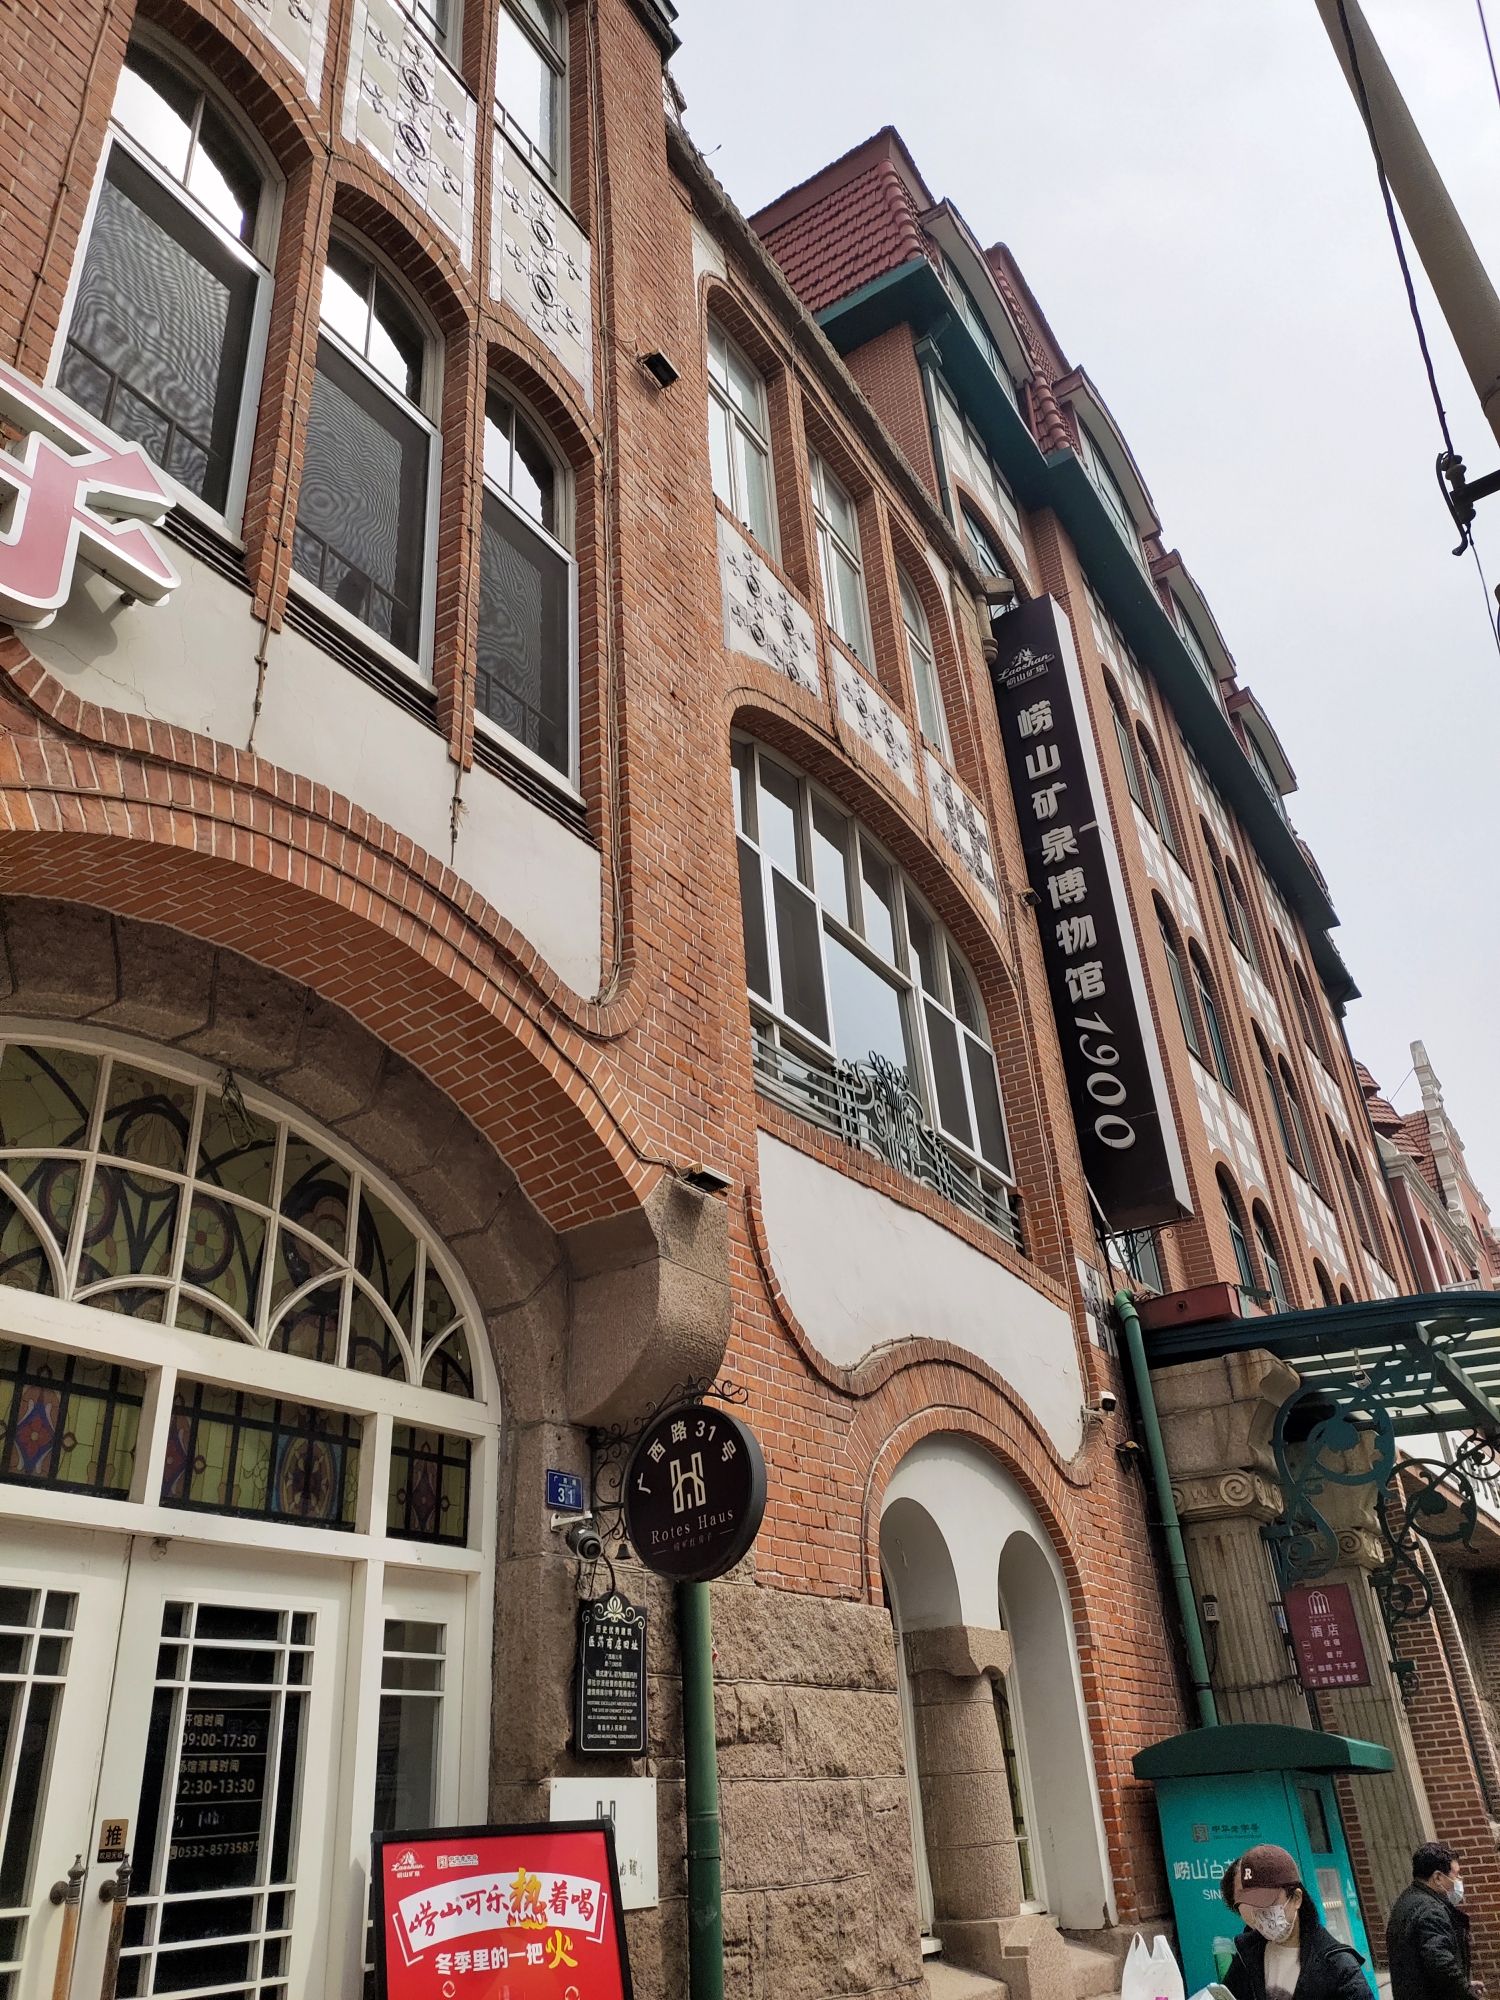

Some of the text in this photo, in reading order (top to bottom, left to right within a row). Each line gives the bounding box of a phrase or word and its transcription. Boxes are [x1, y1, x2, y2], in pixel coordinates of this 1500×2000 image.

[997, 654, 1055, 682] Laoshan
[1018, 700, 1106, 1004] 崂山矿泉博物馆
[1075, 1011, 1136, 1150] 1900
[558, 1487, 573, 1505] 31
[651, 1509, 735, 1545] Rotes Haus
[1310, 1623, 1340, 1638] 酒店
[105, 1825, 122, 1847] 推
[1243, 1868, 1253, 1880] R
[1202, 1889, 1223, 1900] SIN
[435, 1929, 579, 1976] 冬季里的一把火
